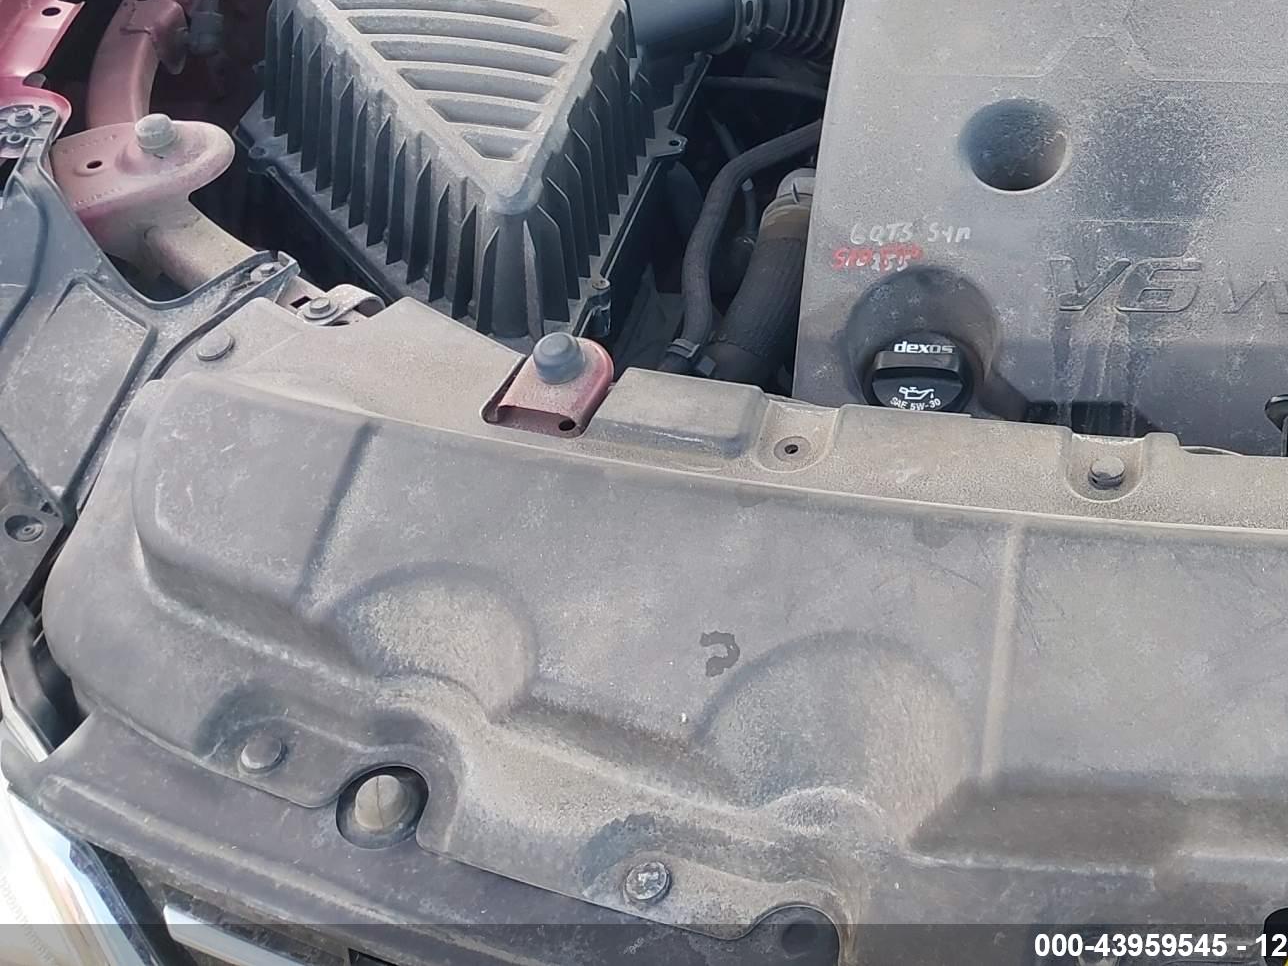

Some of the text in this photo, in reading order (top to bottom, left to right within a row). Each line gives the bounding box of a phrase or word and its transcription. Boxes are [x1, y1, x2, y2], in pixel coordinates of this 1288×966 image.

[1049, 256, 1202, 313] V6
[893, 340, 957, 354] dexos
[890, 396, 942, 412] SAE 5W-30
